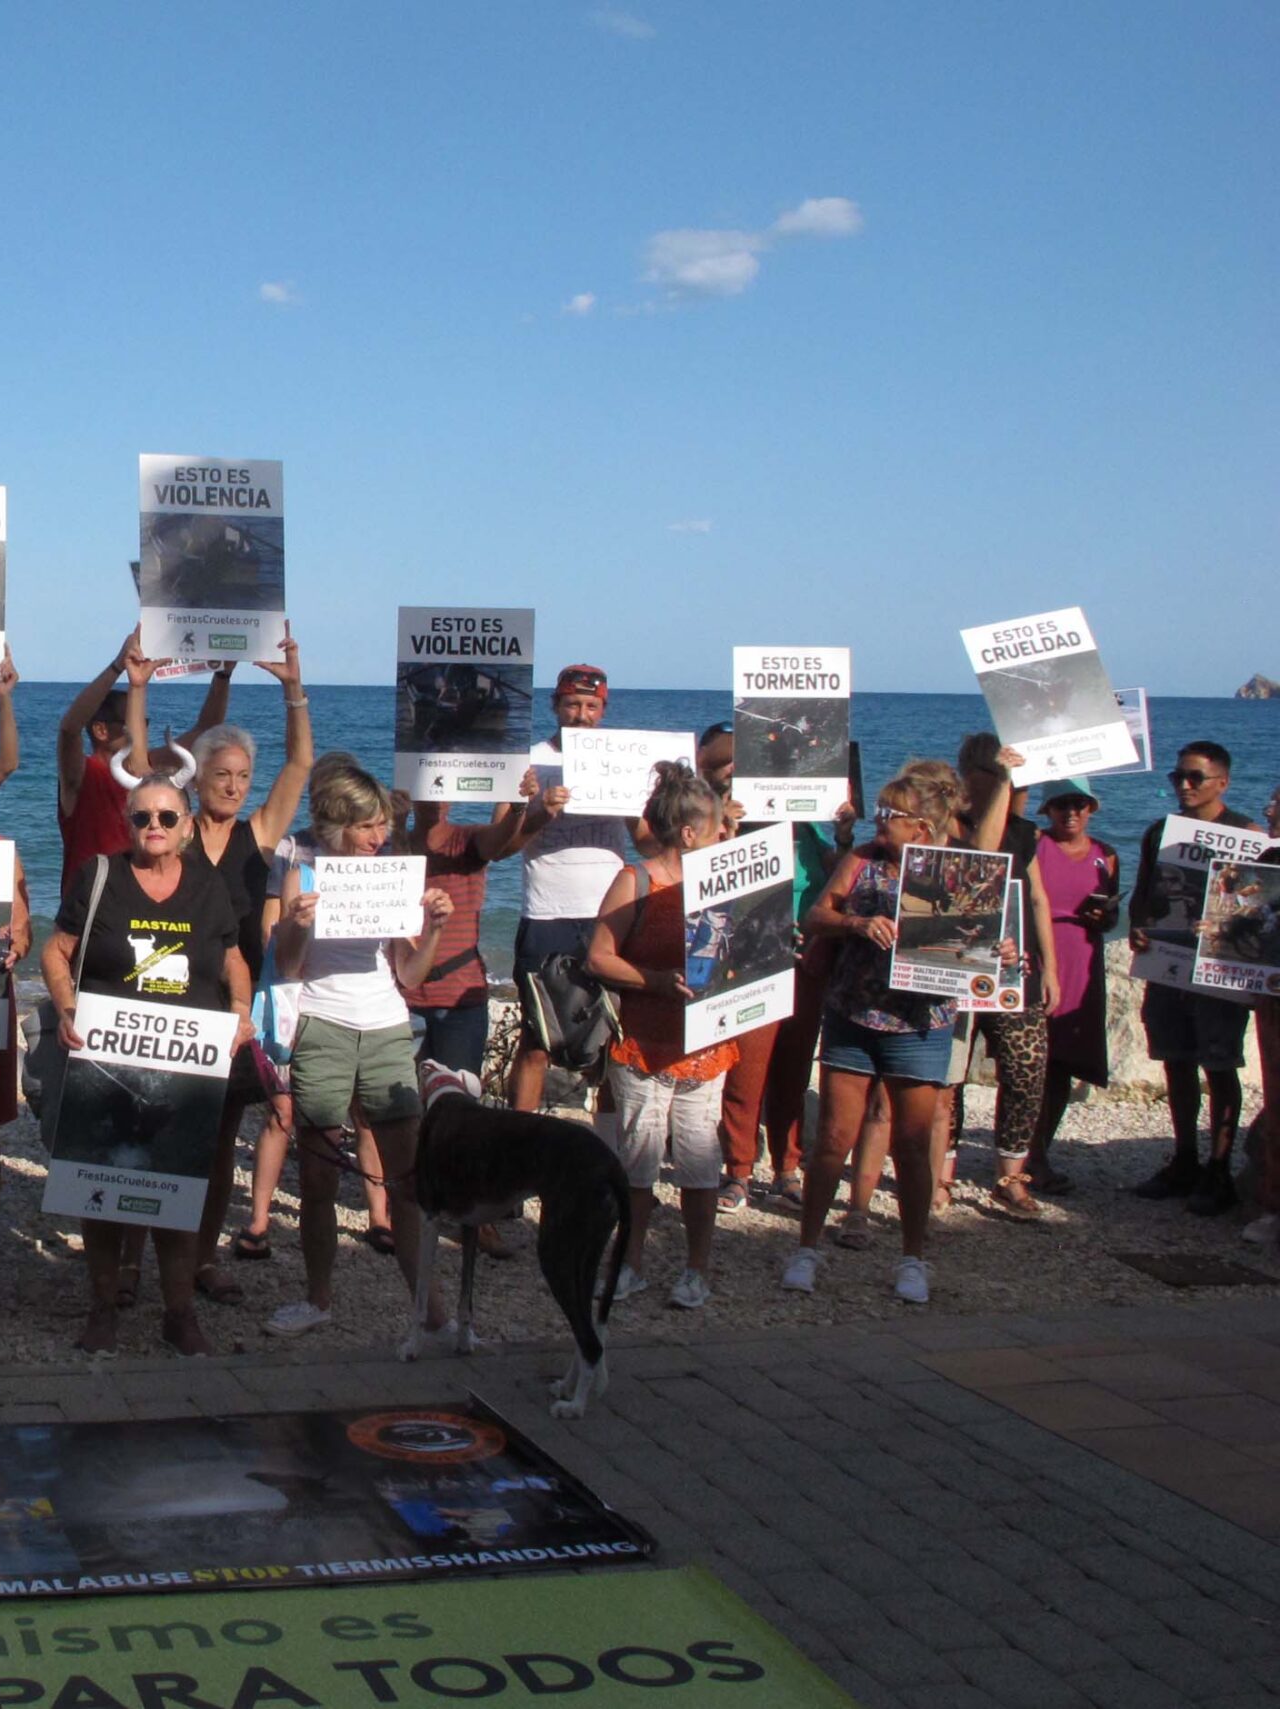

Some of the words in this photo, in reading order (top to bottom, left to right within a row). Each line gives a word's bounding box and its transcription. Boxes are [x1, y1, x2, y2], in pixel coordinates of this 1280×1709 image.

[175, 467, 221, 483] ESTO
[227, 469, 251, 485] ES
[154, 484, 271, 508] VIOLENCIA
[167, 613, 260, 628] FiestasCrueles.org
[431, 617, 476, 632] ESTO
[481, 618, 503, 633] ES
[993, 625, 1033, 643] ESTO
[1036, 620, 1058, 634] ES
[411, 635, 522, 656] VIOLENCIA
[981, 631, 1081, 664] CRUELDAD
[761, 656, 800, 670] ESTO
[803, 657, 822, 670] ES
[743, 673, 840, 690] TORMENTO
[419, 759, 506, 770] FiestasCrueles.org
[570, 786, 651, 801] Cultur
[1194, 830, 1237, 849] ESTO
[1240, 839, 1262, 854] ES
[325, 862, 407, 874] ALCALDESA
[710, 848, 746, 872] ESTO
[750, 841, 768, 860] ES
[699, 856, 780, 900] MARTIRIO
[130, 919, 191, 932] BASTA!!!
[114, 1011, 168, 1034] ESTO
[173, 1019, 200, 1038] ES
[86, 1028, 219, 1066] CRUELDAD
[77, 1168, 179, 1192] FiestasCrueles.org
[76, 1571, 192, 1590] ABUSE
[193, 1566, 294, 1583] STOP
[295, 1541, 640, 1578] TIERMISSHANDLUNG
[322, 1611, 433, 1642] es
[333, 1640, 767, 1704] TODOS
